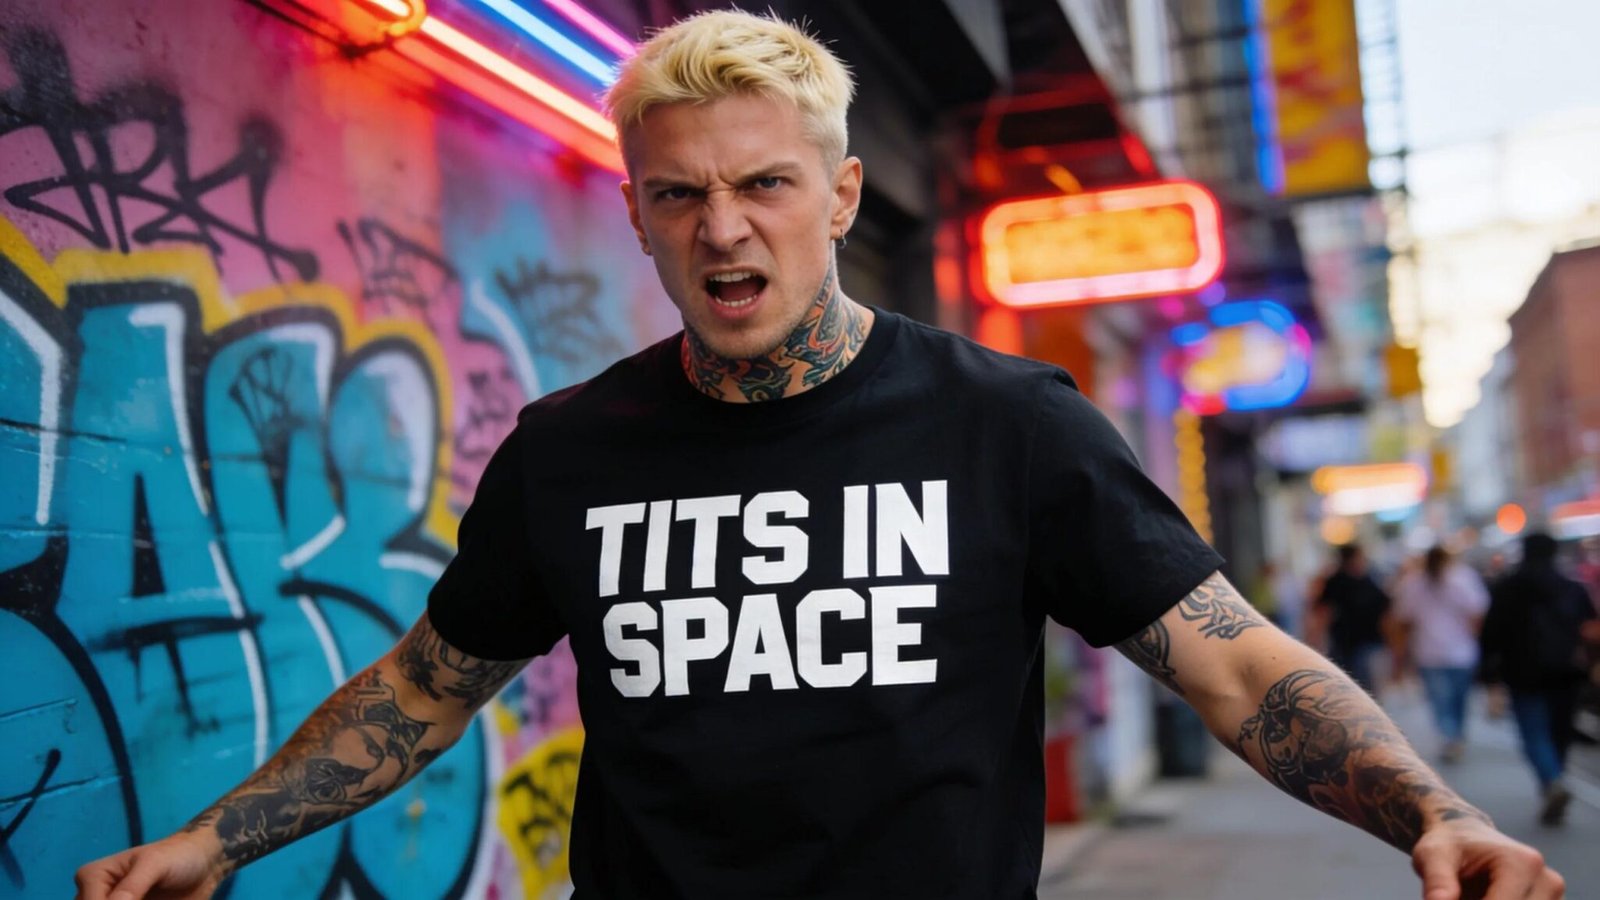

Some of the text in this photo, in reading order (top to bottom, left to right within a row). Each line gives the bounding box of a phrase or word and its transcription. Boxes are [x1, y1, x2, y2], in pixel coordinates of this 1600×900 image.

[585, 479, 950, 598] TITS IN
[602, 583, 938, 698] SPACE
